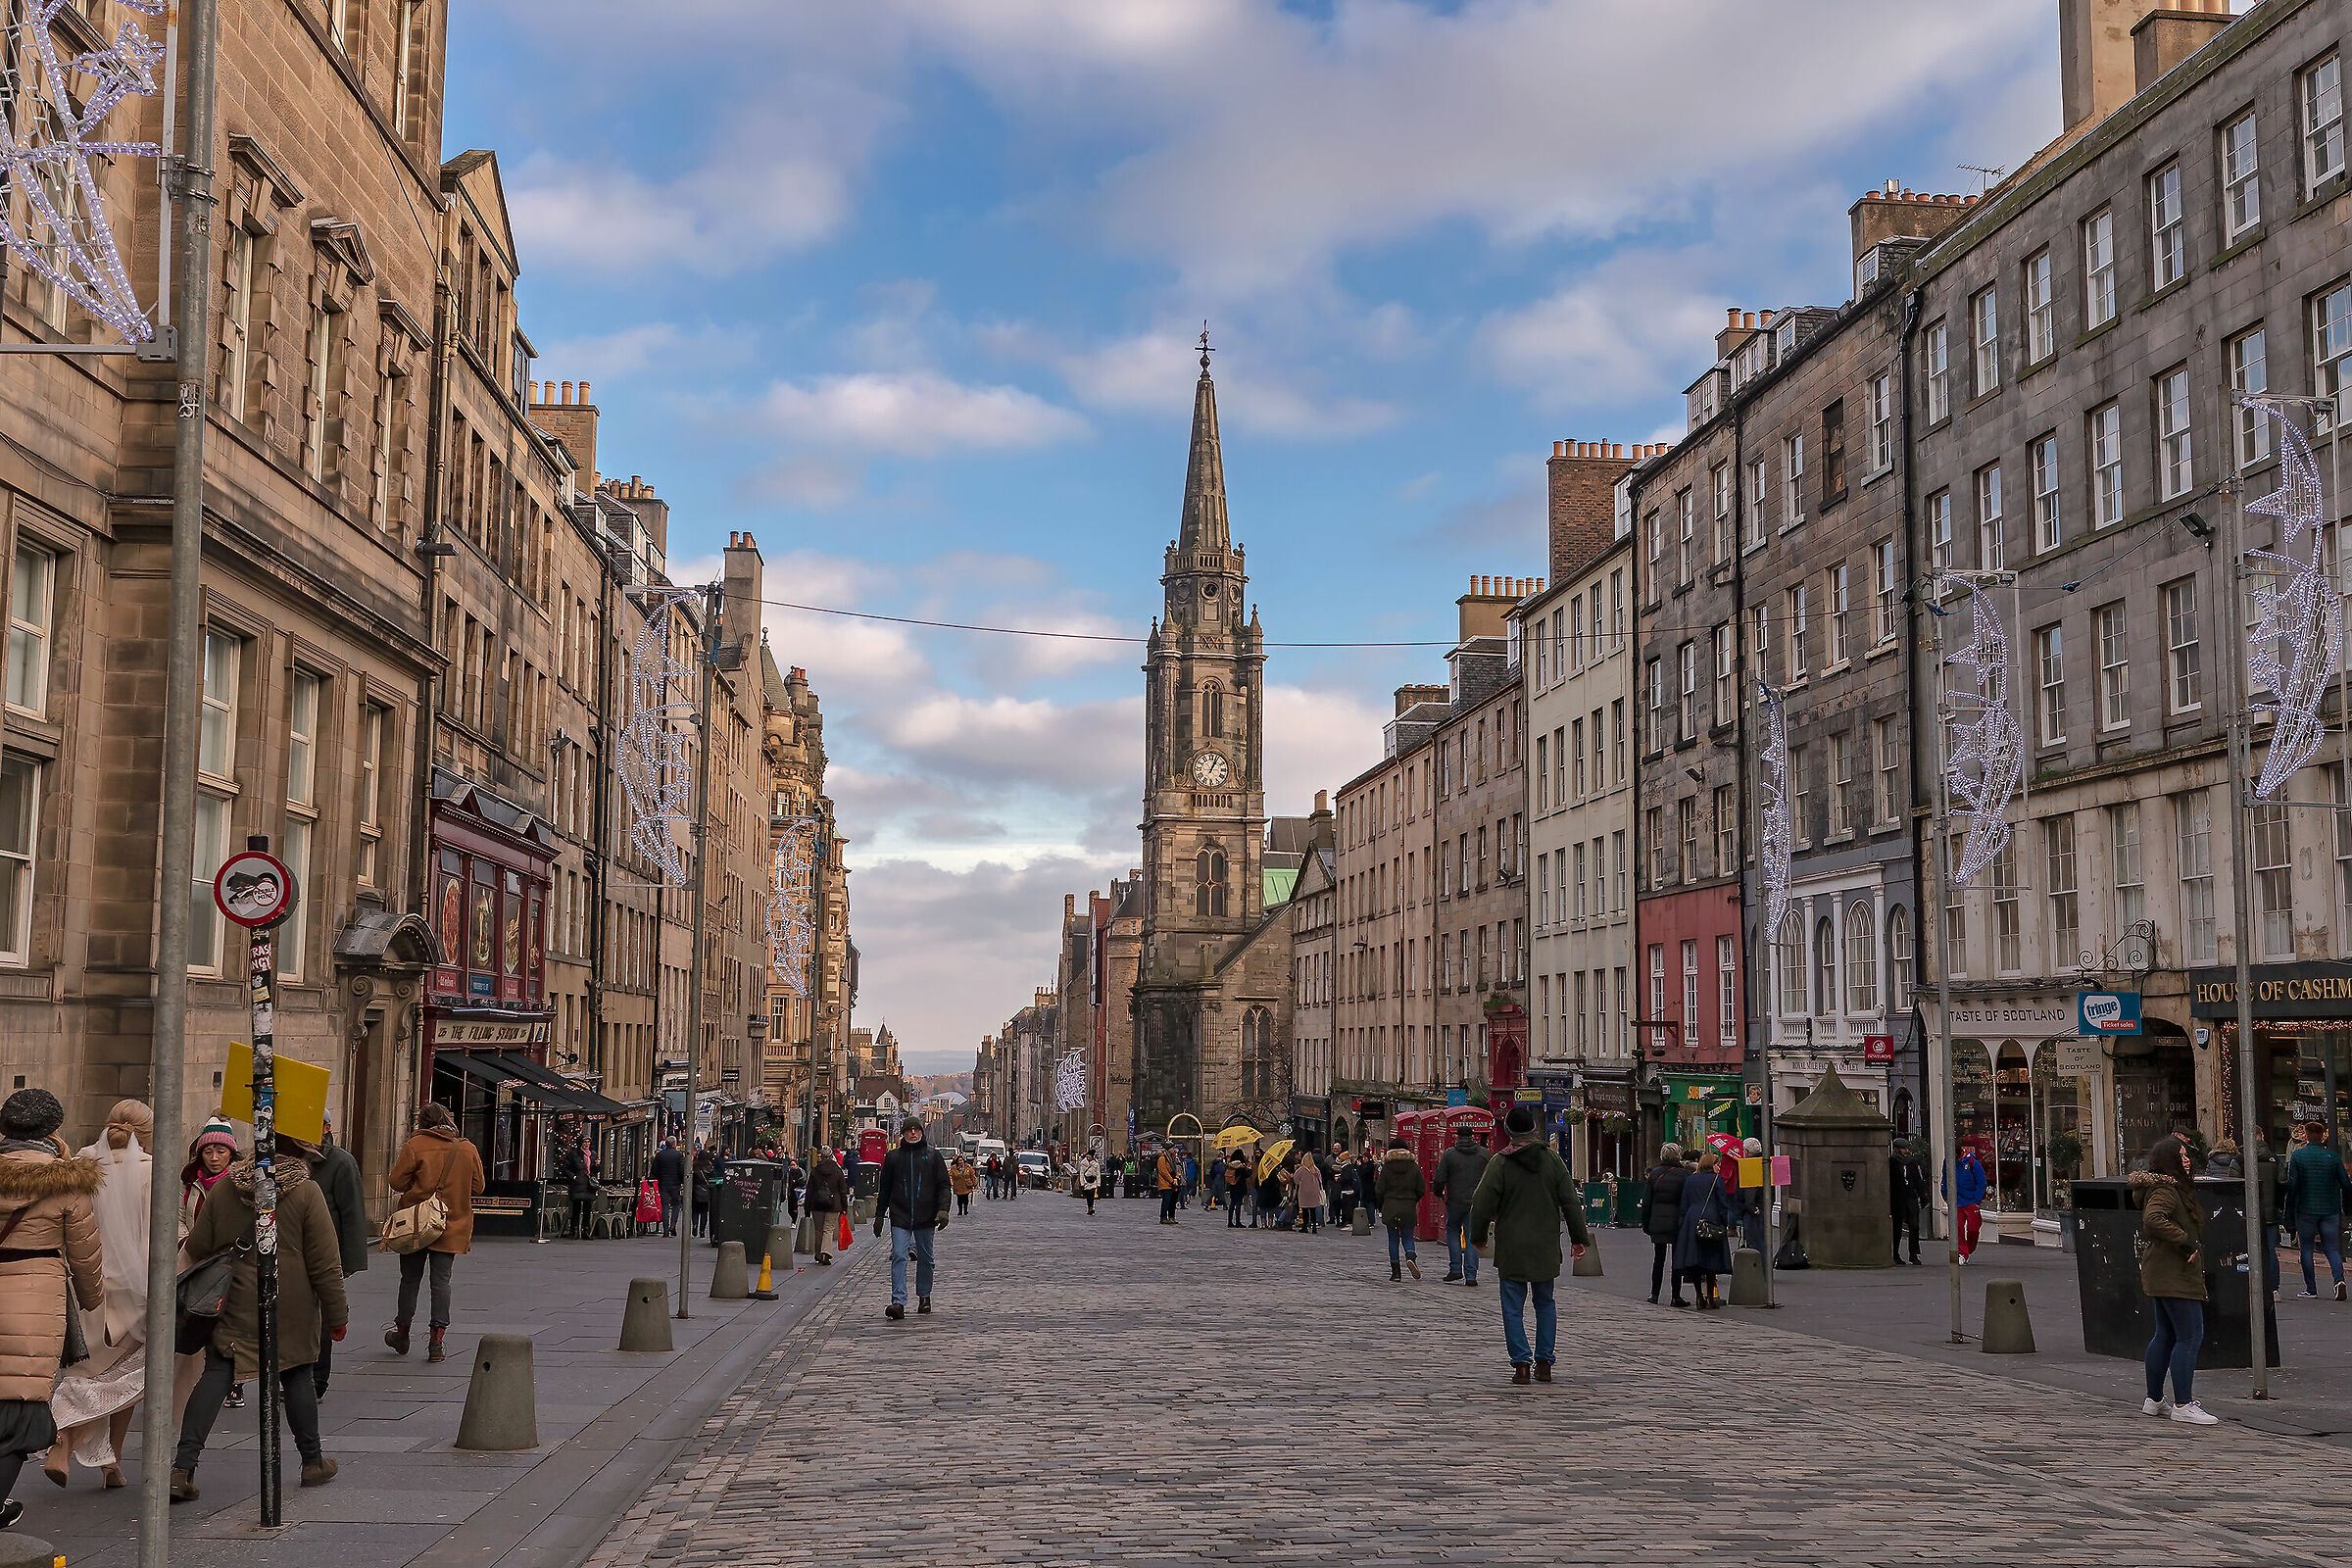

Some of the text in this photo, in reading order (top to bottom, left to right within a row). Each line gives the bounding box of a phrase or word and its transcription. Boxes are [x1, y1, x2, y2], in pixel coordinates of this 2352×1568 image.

[2196, 982, 2254, 1003] HOU
[2259, 980, 2284, 1002] OF
[1949, 1008, 2066, 1022] TASTE OF SCOTLAND
[2086, 1001, 2118, 1016] fringe
[451, 1025, 466, 1040] THE
[1708, 1100, 1733, 1119] SUBWAY
